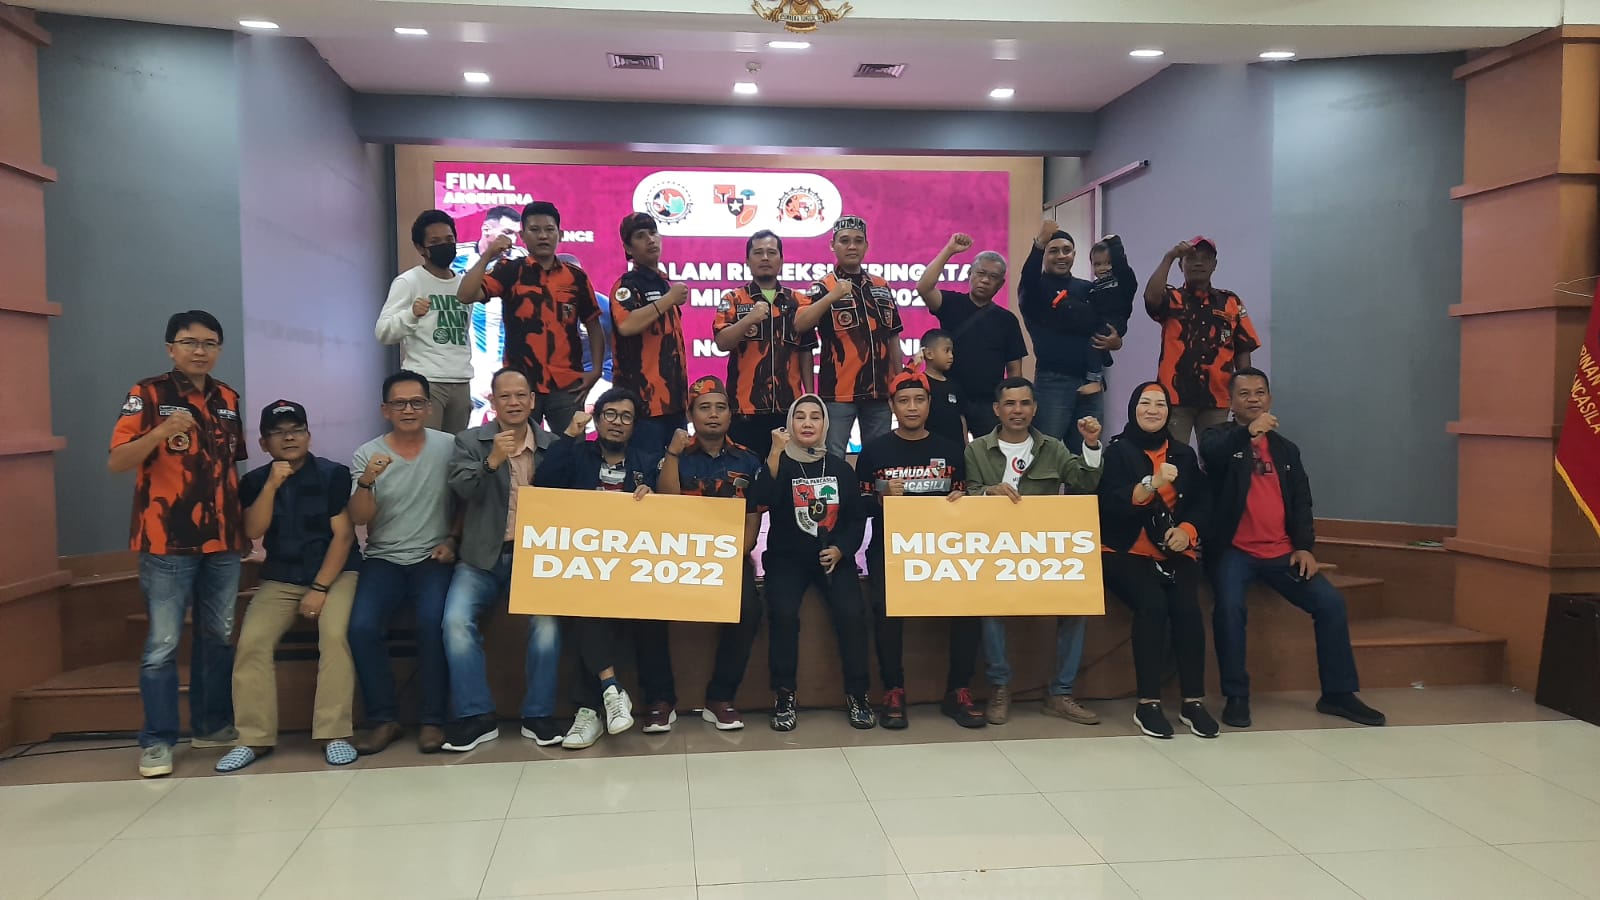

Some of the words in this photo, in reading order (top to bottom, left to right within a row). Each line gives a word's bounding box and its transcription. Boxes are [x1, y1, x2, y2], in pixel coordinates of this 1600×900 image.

[445, 172, 516, 191] FINAL
[443, 192, 534, 205] ARGENTINA
[885, 467, 931, 479] PEMUDA
[522, 525, 738, 559] MIGRANTS
[891, 531, 1096, 555] MIGRANTS
[532, 554, 620, 581] DAY
[630, 559, 724, 586] 2022
[904, 558, 985, 582] DAY
[994, 558, 1086, 581] 2022
